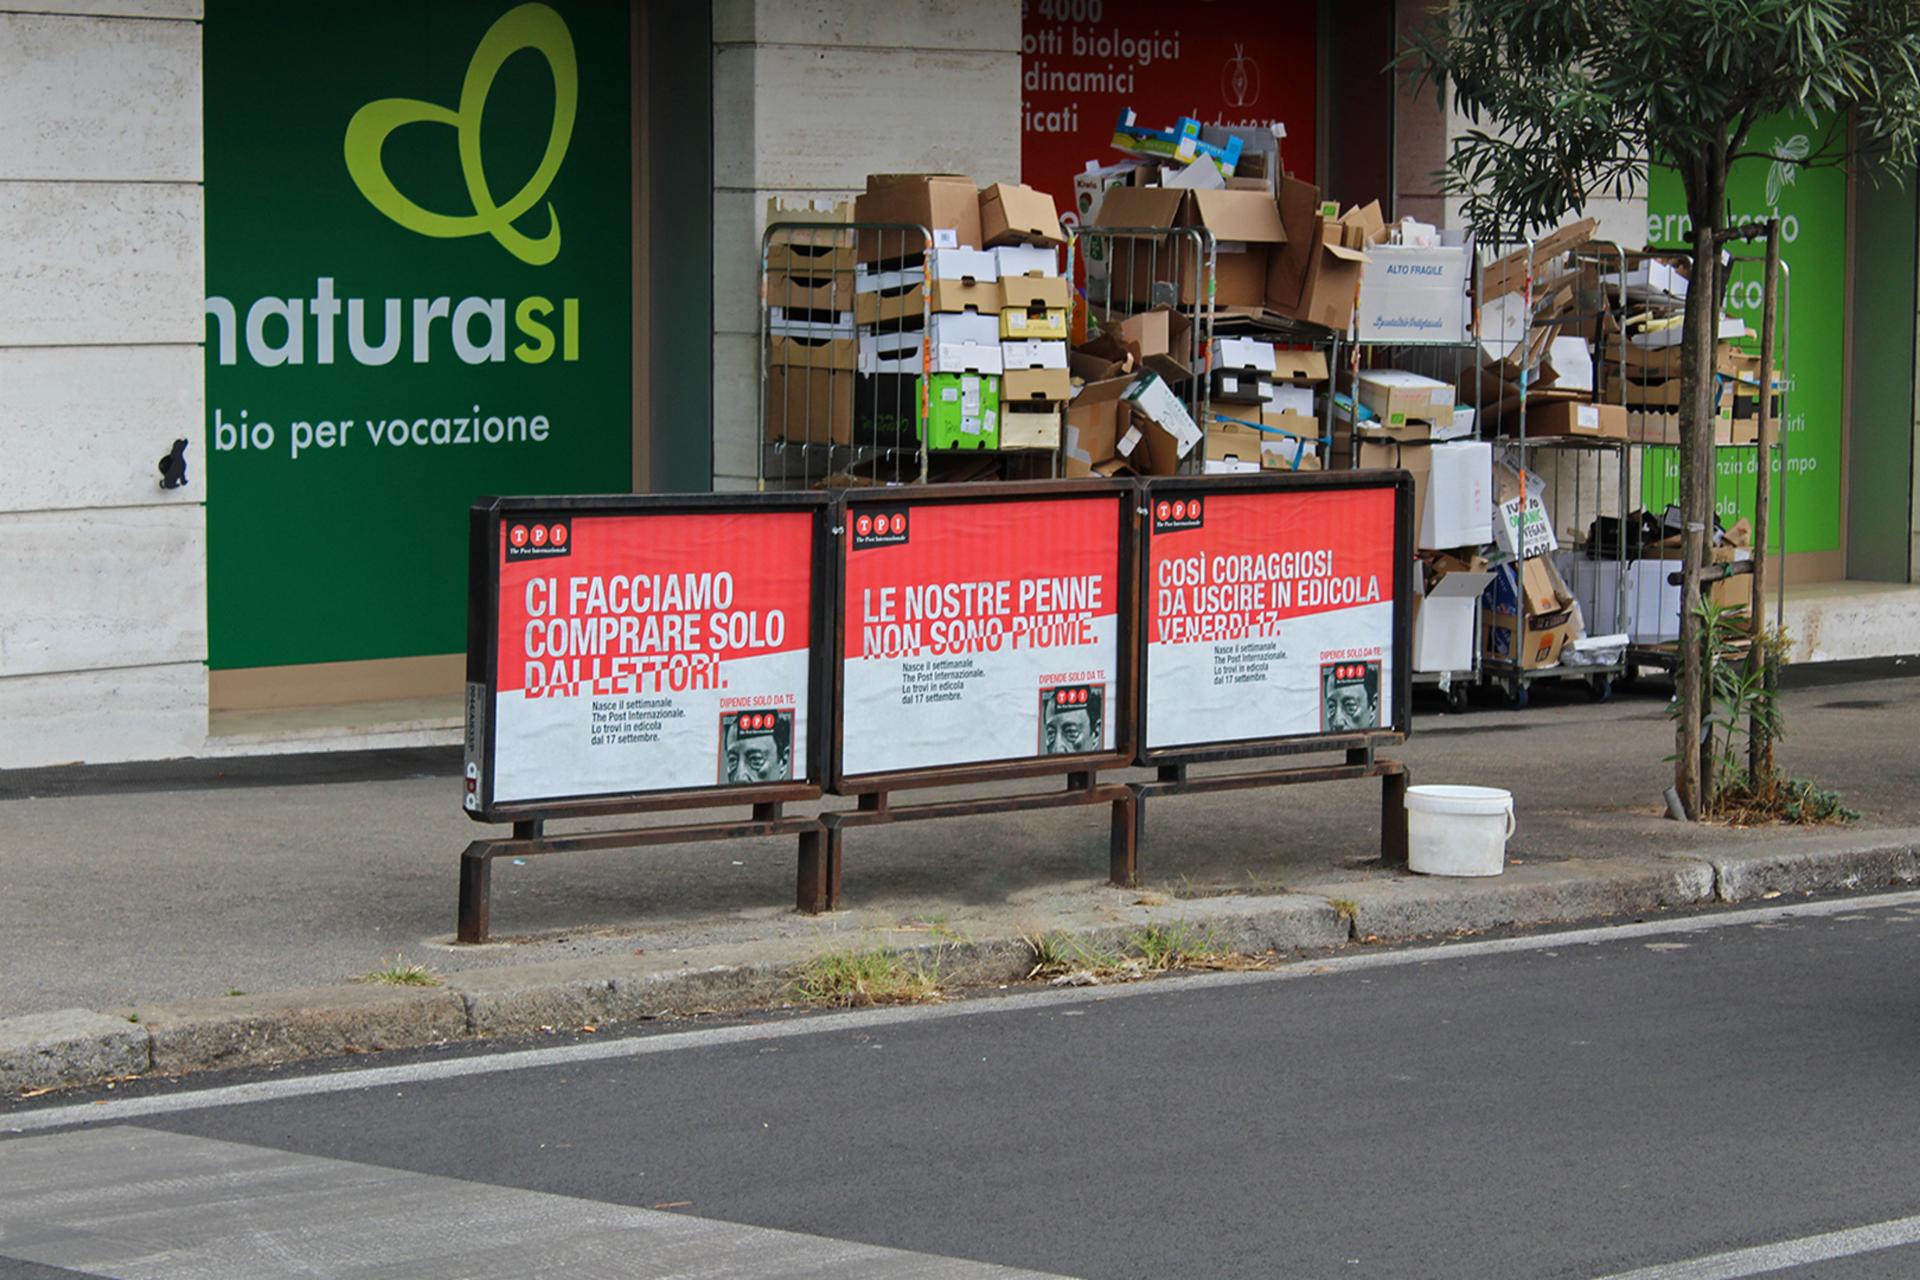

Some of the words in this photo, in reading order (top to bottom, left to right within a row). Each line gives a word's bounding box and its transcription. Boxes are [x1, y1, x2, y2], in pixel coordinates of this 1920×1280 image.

[1072, 27, 1180, 66] biologici
[1025, 62, 1134, 93] dinamici
[1021, 102, 1078, 132] icati
[1387, 264, 1409, 275] ALTO
[1410, 265, 1443, 276] FRAGILE
[215, 409, 275, 450] bio
[290, 418, 354, 459] per
[366, 405, 550, 447] vocazione
[1159, 502, 1199, 518] TPI
[859, 516, 903, 533] TPI
[512, 527, 564, 544] TPI
[1158, 551, 1206, 588] COSÌ
[1212, 549, 1332, 585] CORAGGIOSI
[525, 577, 557, 617] CI
[569, 571, 733, 616] FACCIAMO
[864, 587, 896, 624] LE
[905, 580, 1010, 621] NOSTRE
[1018, 575, 1102, 613] PENNE
[1158, 588, 1187, 617] DA
[1193, 583, 1266, 616] USCIRE
[1272, 582, 1291, 609] IN
[1298, 575, 1380, 607] EDICOLA
[525, 614, 700, 658] COMPRARE
[709, 609, 785, 650] SOLO
[1157, 605, 1249, 645] VENERDÌ
[1256, 611, 1281, 638] 17.
[864, 623, 920, 660] NON
[930, 616, 1002, 656] SONO
[1012, 612, 1098, 650] PIUME.
[903, 663, 924, 672] Nasce
[926, 662, 931, 670] il
[525, 659, 581, 699] DAI
[593, 653, 729, 696] LETTORI.
[903, 673, 915, 682] The
[917, 672, 933, 682] Post
[902, 685, 911, 694] Lo
[913, 683, 929, 693] trovi
[930, 683, 937, 691] in
[939, 681, 964, 691] edicola
[592, 701, 617, 711] Nasce
[619, 700, 624, 710] il
[626, 697, 672, 709] settimanale
[720, 696, 752, 708] DIPENDE
[753, 695, 772, 706] SOLO
[774, 695, 784, 705] DA
[902, 695, 913, 704] dal
[915, 694, 924, 703] 17
[925, 692, 962, 703] settembre.
[592, 713, 607, 722] The
[608, 711, 627, 721] Post
[628, 708, 686, 720] Internazionale.
[591, 724, 602, 734] Lo
[603, 723, 621, 733] trovi
[623, 723, 631, 732] in
[633, 720, 662, 731] edicola
[591, 735, 604, 745] dal
[606, 734, 616, 744] 17
[618, 733, 660, 744] settembre.
